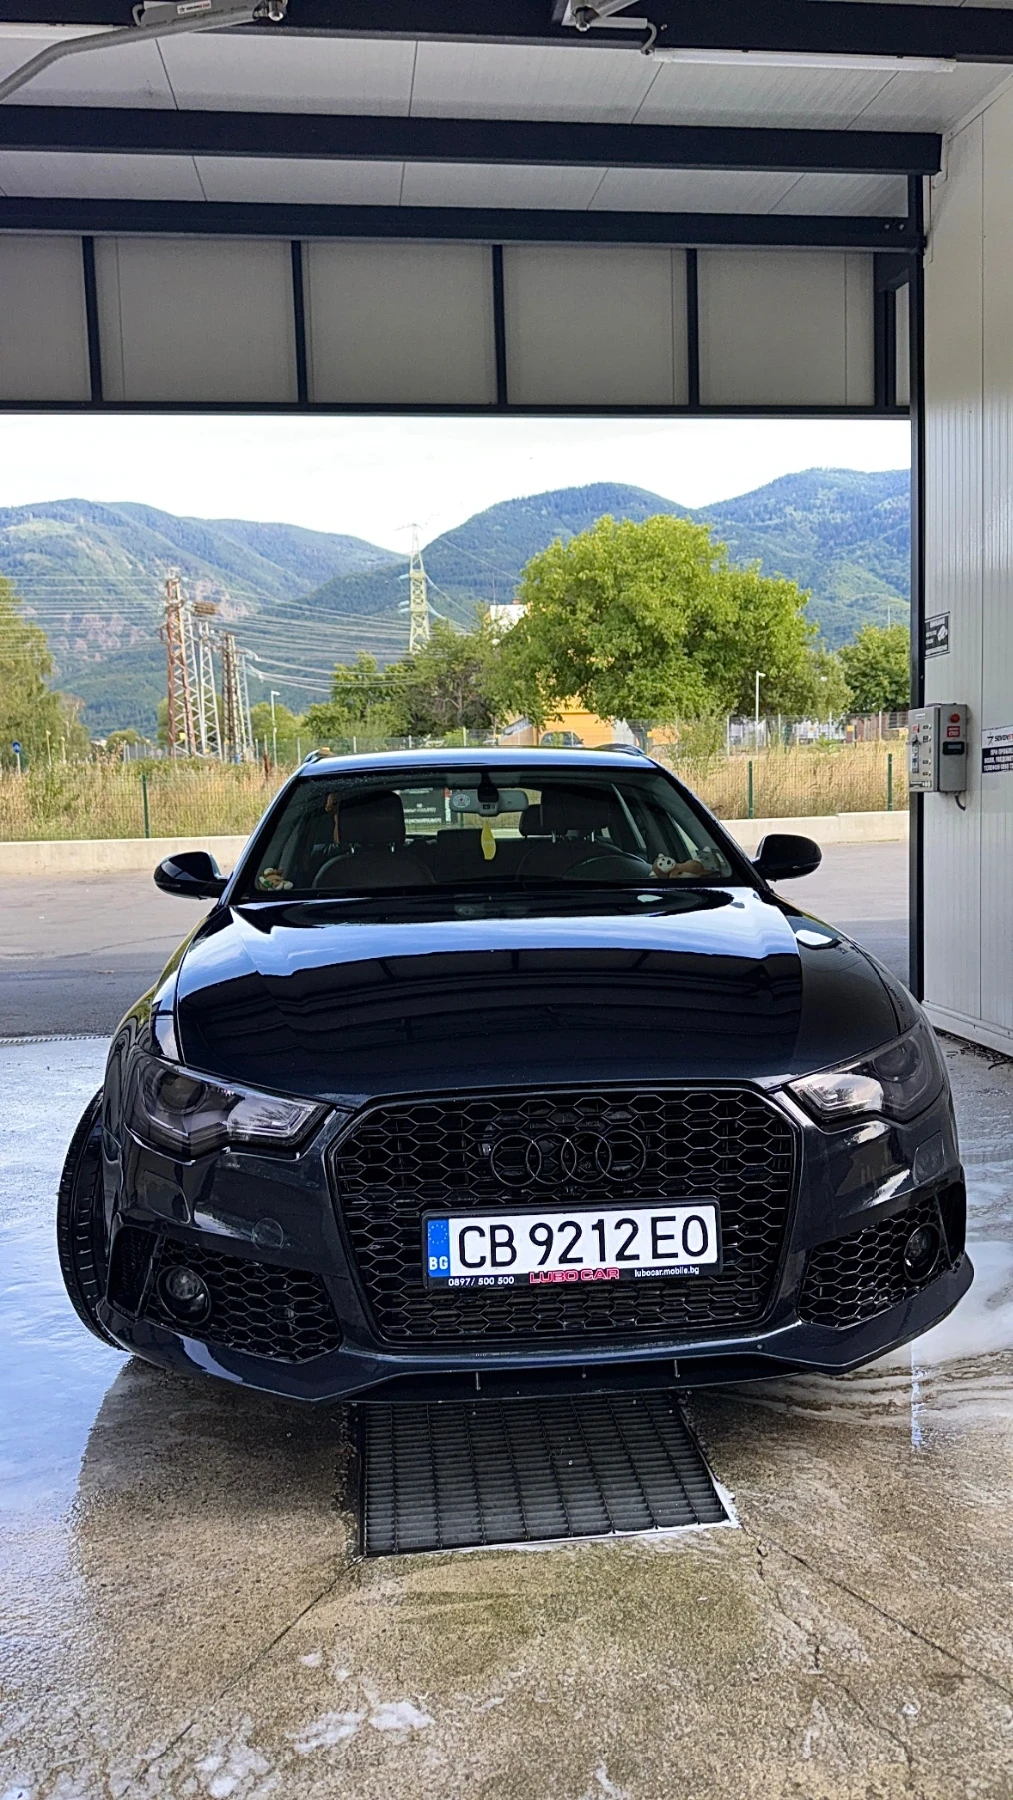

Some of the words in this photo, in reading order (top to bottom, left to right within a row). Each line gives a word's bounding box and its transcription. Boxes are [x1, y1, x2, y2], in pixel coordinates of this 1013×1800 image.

[458, 1224, 517, 1269] CB
[529, 1218, 640, 1266] 9212
[429, 1256, 448, 1270] BG
[529, 1269, 579, 1284] LUBO
[580, 1267, 620, 1281] CAR
[634, 1266, 700, 1278] lubocar.mobile.bg
[448, 1277, 475, 1287] 0897/
[478, 1277, 495, 1286] 500
[497, 1275, 515, 1285] 500
